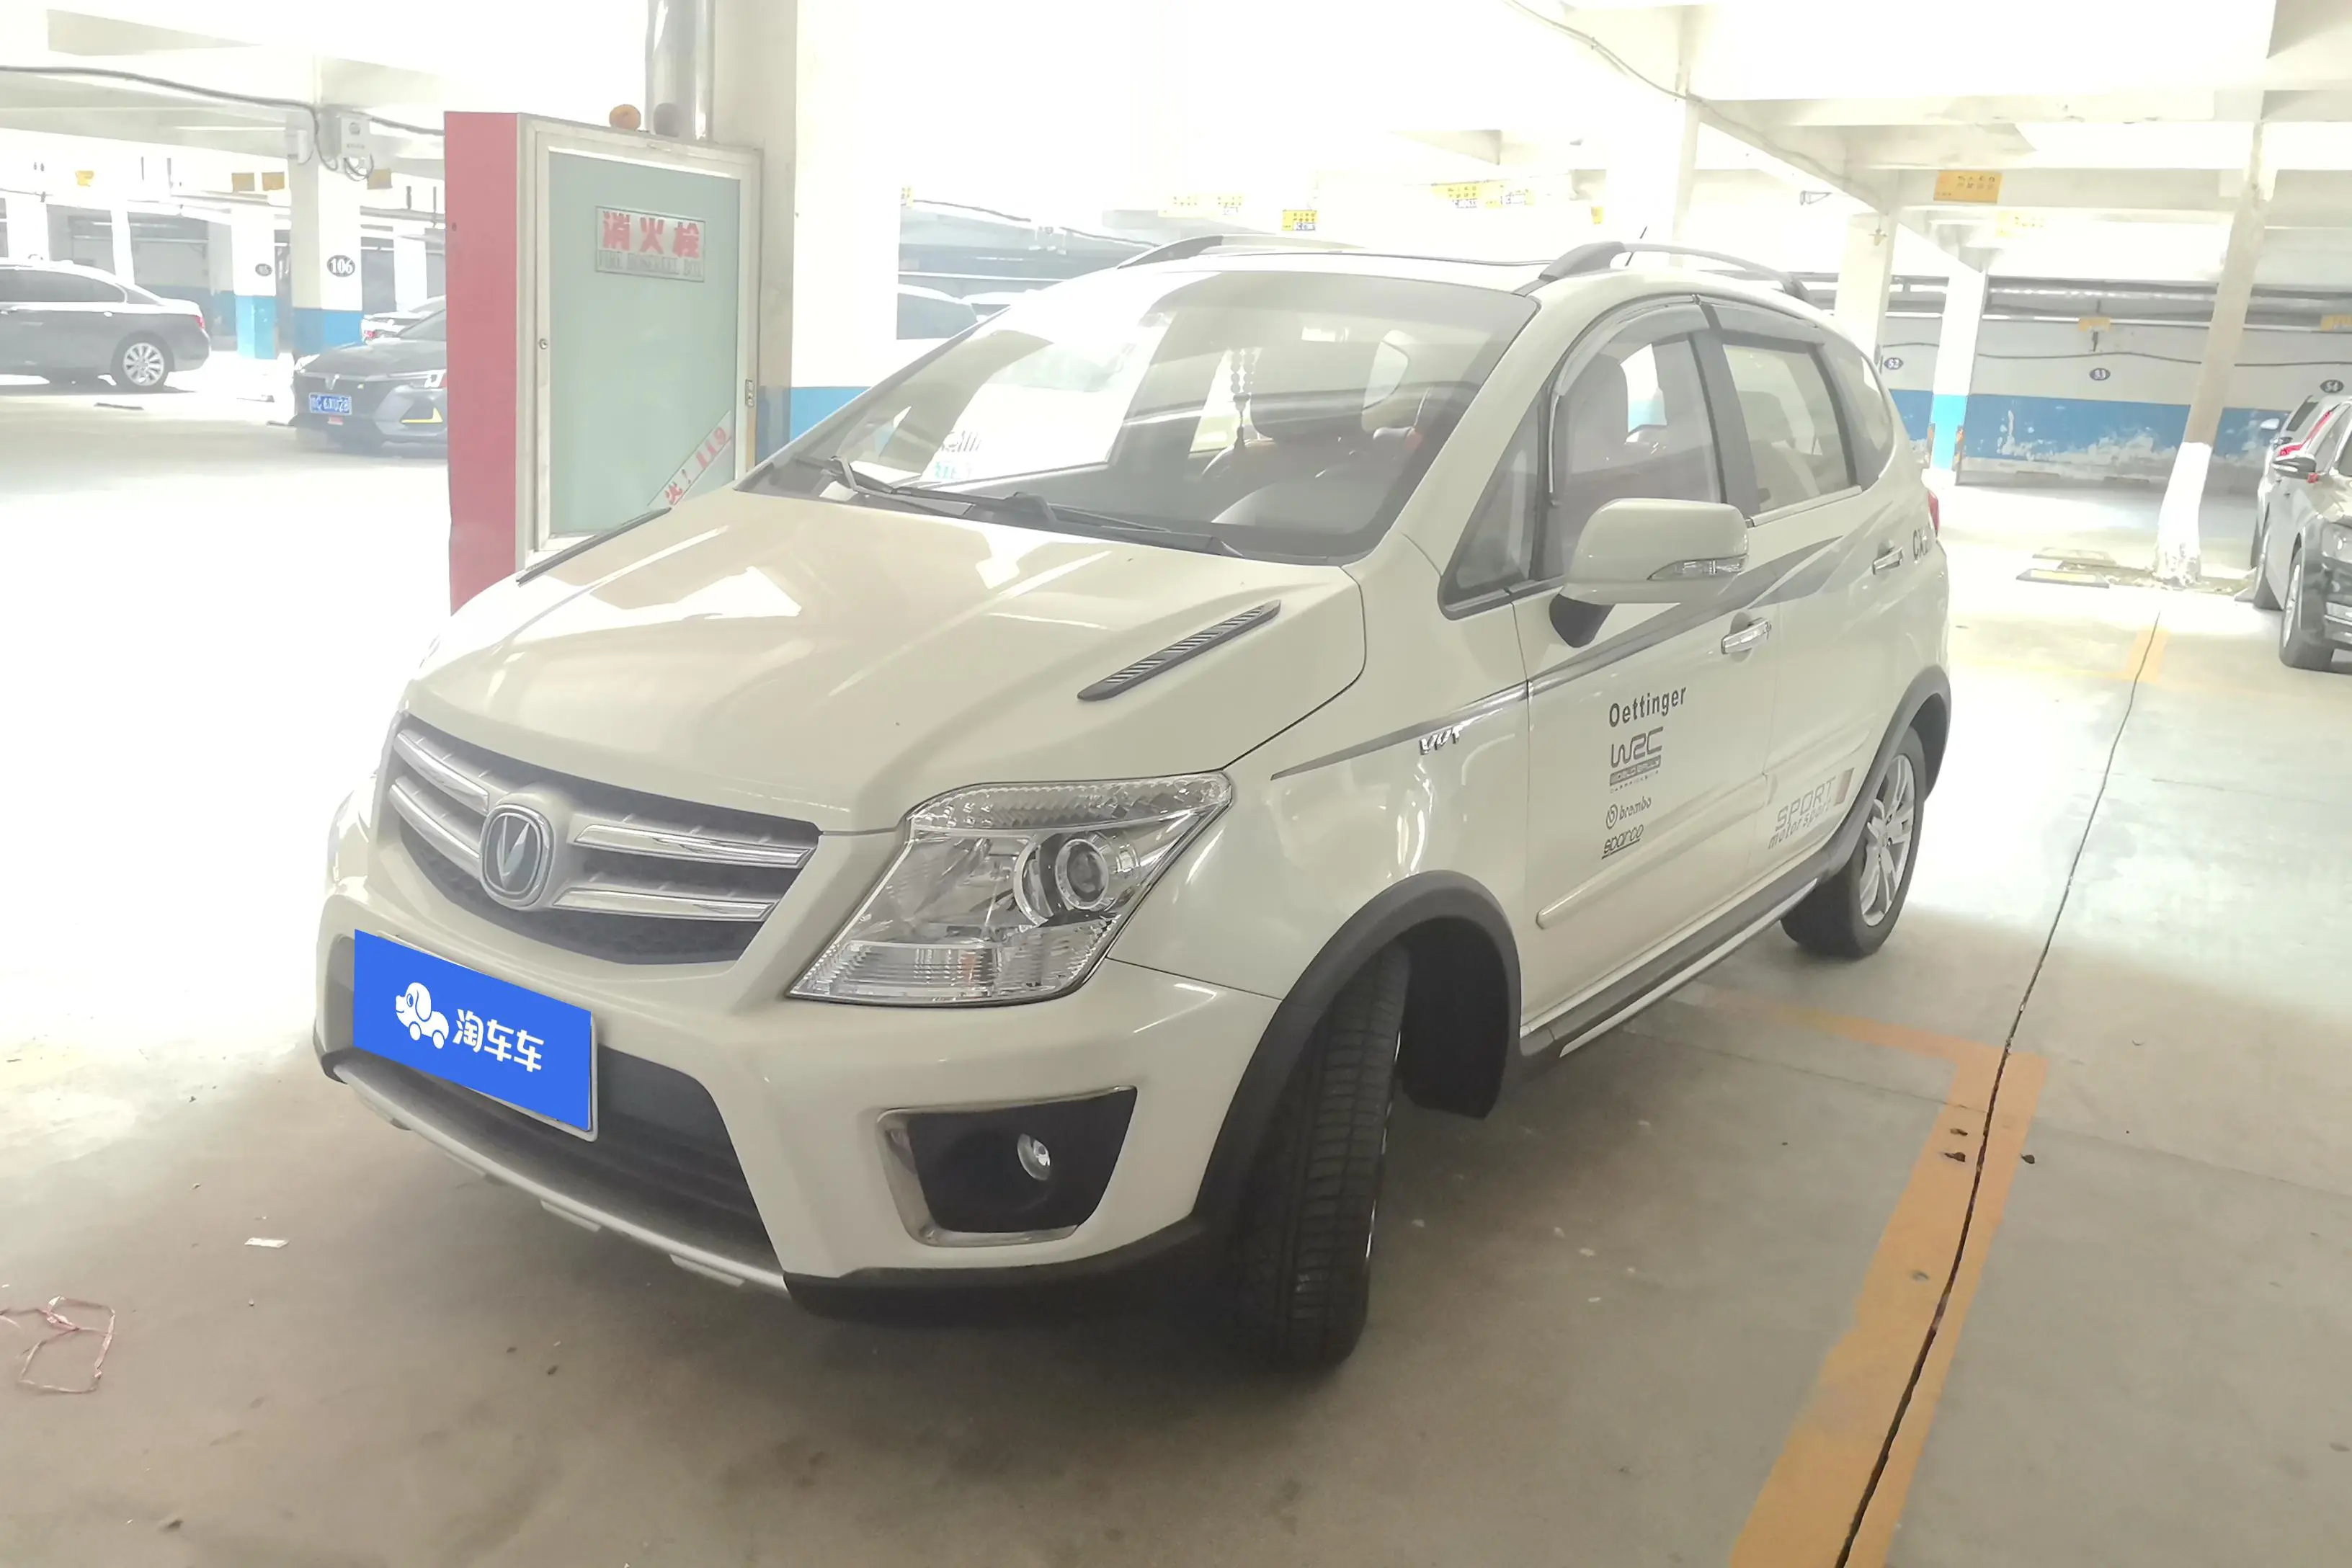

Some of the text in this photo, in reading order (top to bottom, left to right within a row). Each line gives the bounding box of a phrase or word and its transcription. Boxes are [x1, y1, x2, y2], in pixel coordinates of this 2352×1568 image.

[602, 210, 700, 259] 消火栓
[331, 258, 353, 274] 106
[1608, 686, 1687, 728] Oettinger
[1775, 775, 1835, 832] SPORT
